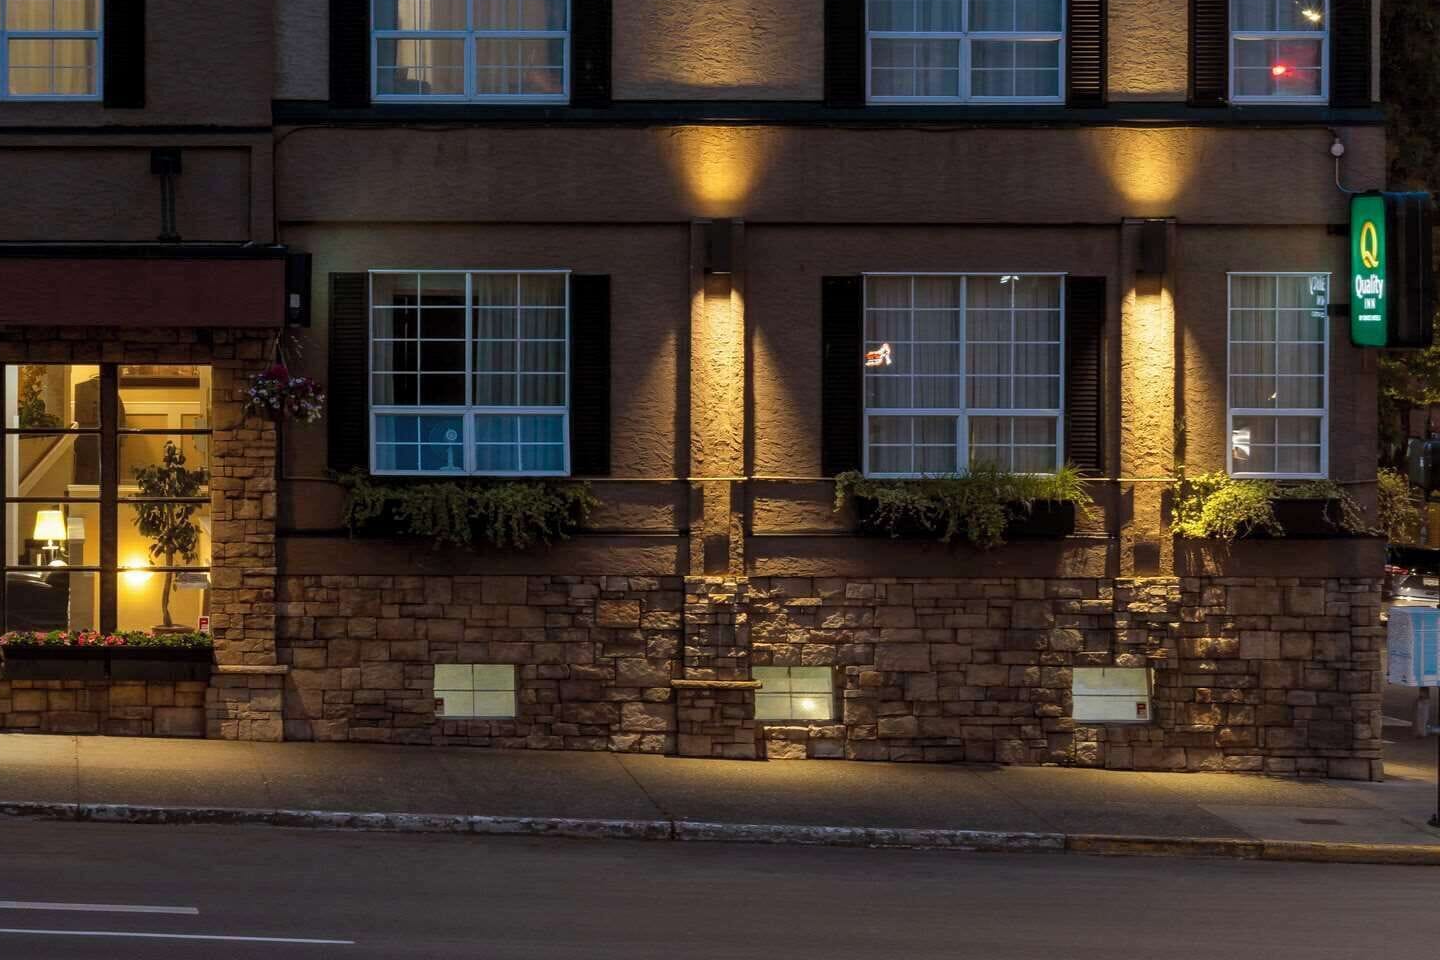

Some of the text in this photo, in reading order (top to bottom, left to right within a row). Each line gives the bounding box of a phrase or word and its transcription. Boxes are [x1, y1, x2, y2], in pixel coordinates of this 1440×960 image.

[1360, 221, 1379, 269] Q
[1355, 274, 1384, 299] Quality
[1364, 297, 1376, 309] INN
